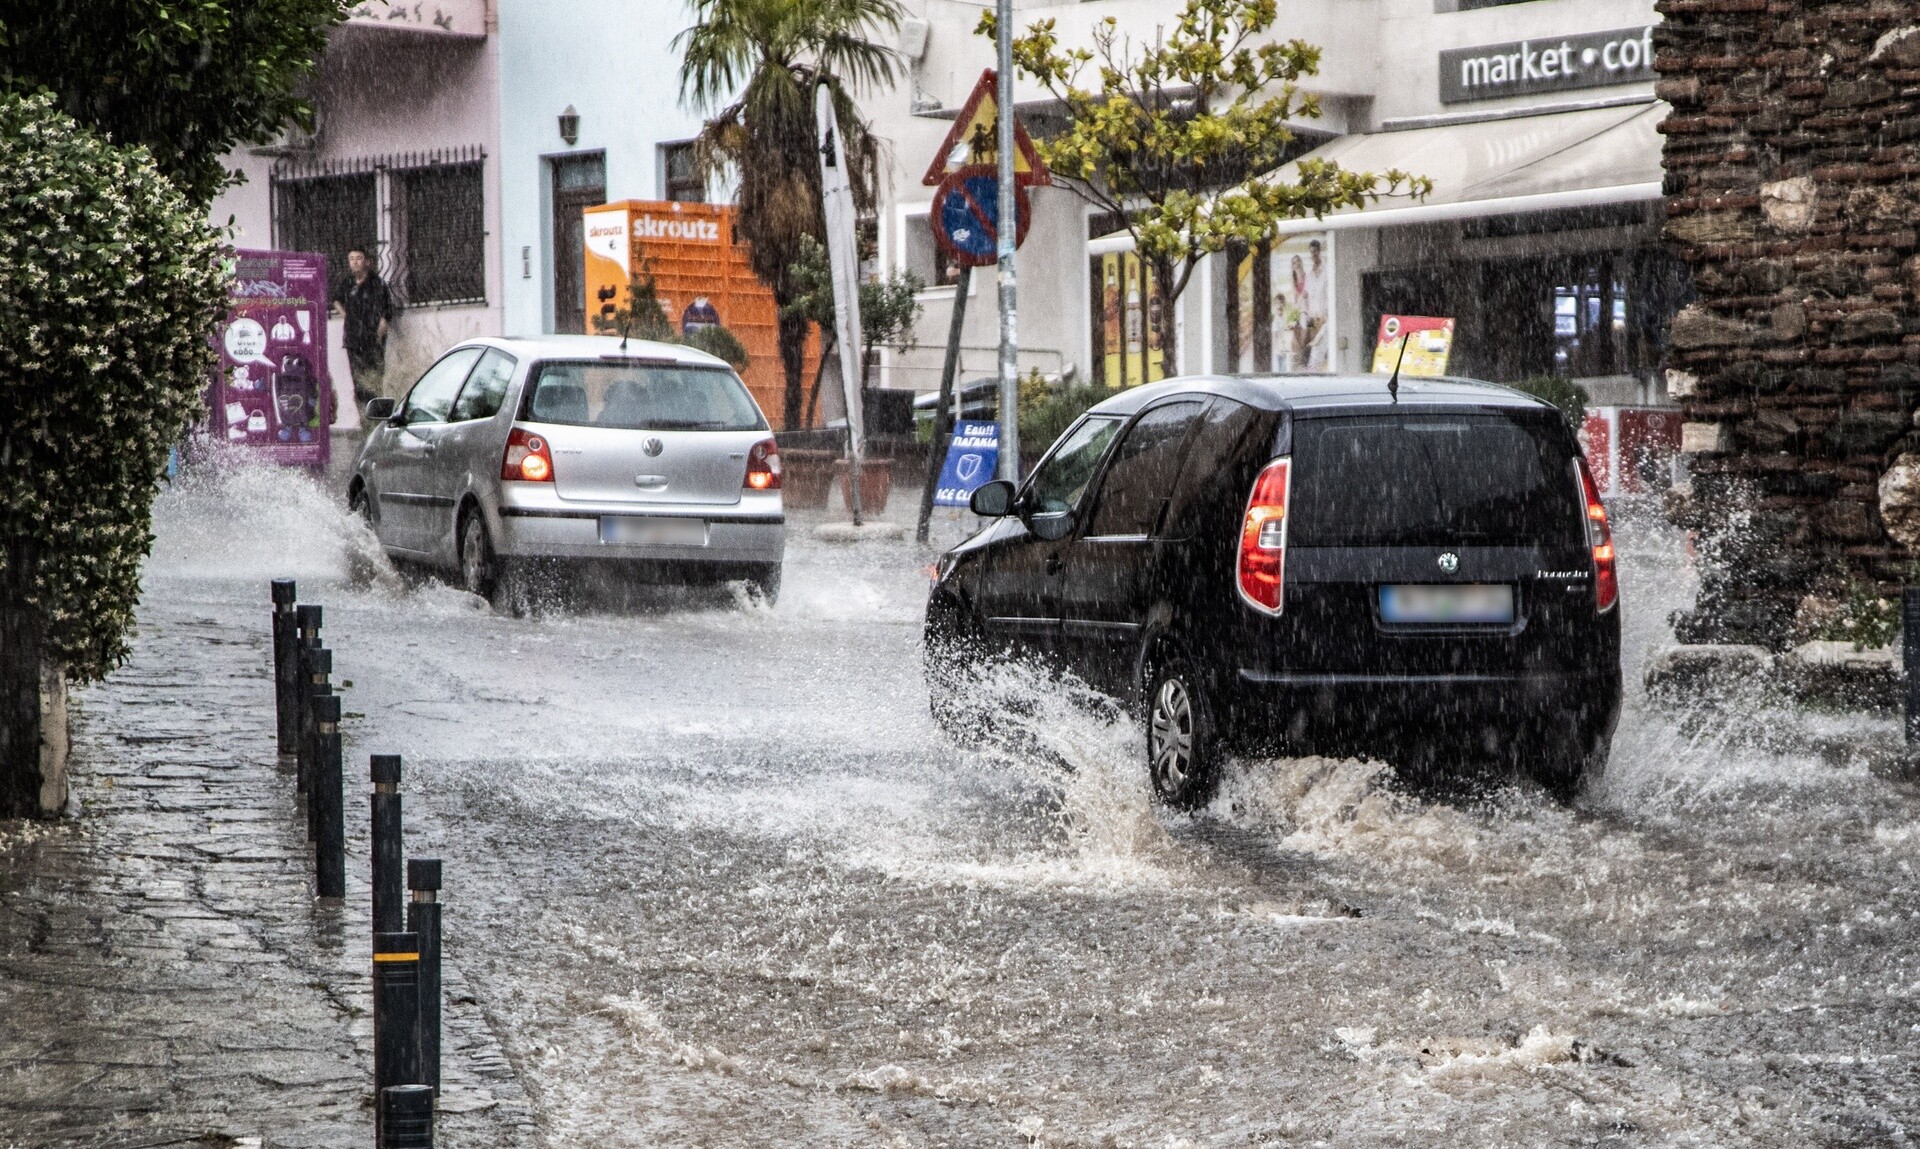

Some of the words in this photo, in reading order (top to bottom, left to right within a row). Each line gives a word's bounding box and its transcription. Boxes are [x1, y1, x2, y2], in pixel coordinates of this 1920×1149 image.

[1461, 41, 1574, 86] market
[589, 225, 623, 238] skroutz
[633, 213, 718, 240] skroutz
[952, 436, 998, 448] ΠΑΓΑΚΙΑ
[935, 488, 955, 500] ICE
